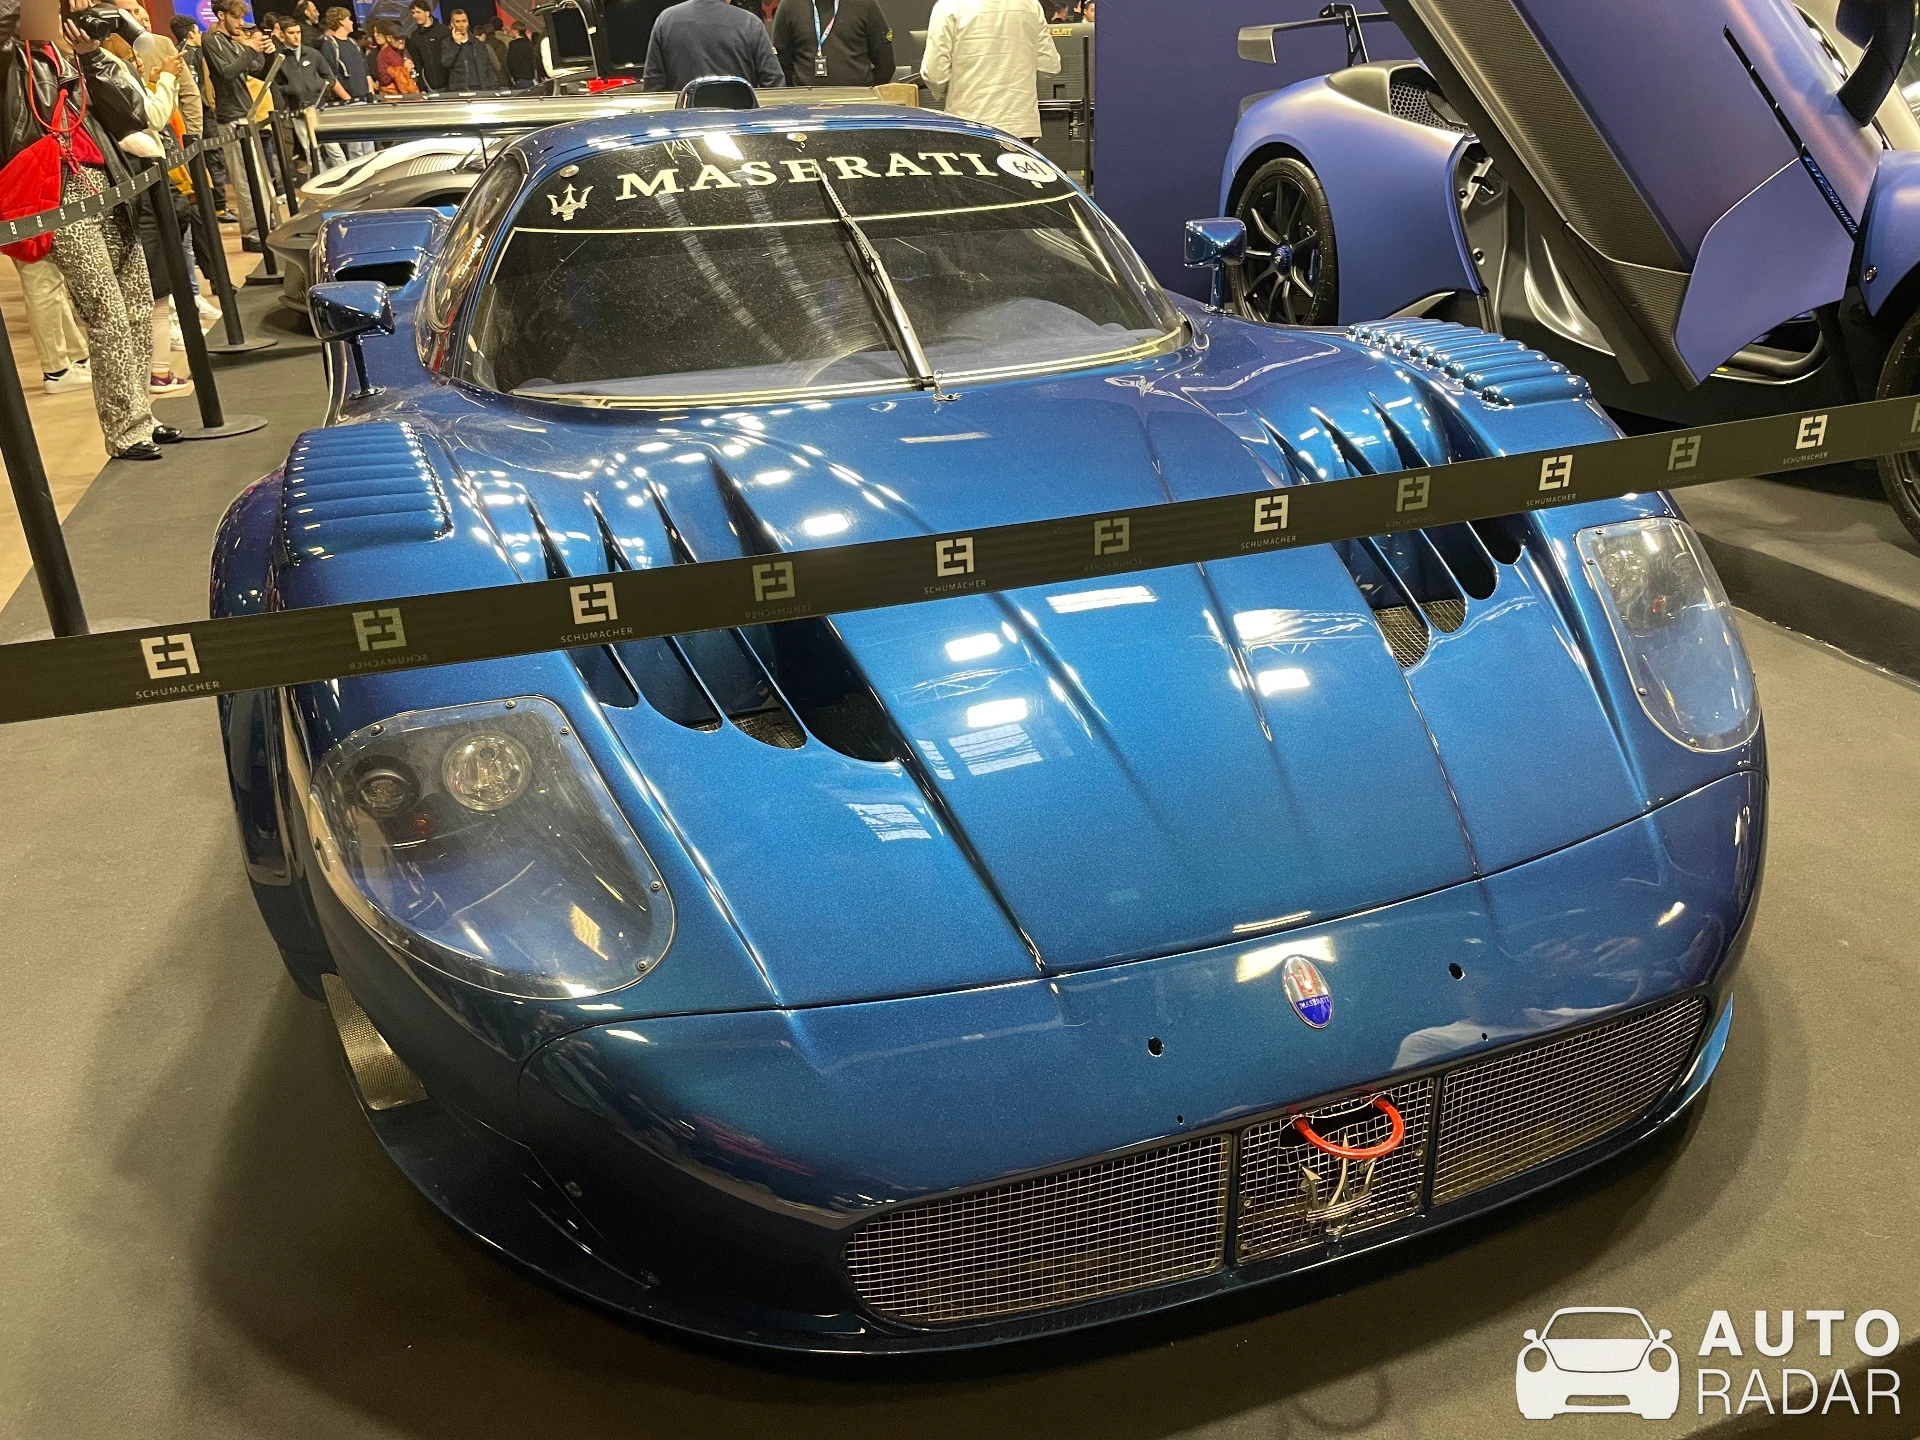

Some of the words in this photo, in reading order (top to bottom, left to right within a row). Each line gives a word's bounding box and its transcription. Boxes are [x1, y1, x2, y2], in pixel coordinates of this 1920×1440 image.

[1013, 160, 1048, 176] 641
[616, 152, 999, 201] MASERATI
[1782, 451, 1828, 465] SCHUMACHER
[1526, 493, 1576, 507] SCHUMACHER
[1240, 535, 1296, 550] SCHUMACHER
[924, 579, 986, 595] SCHUMACHER
[560, 627, 633, 643] SCHUMACHER
[135, 681, 220, 699] SCHUMACHER
